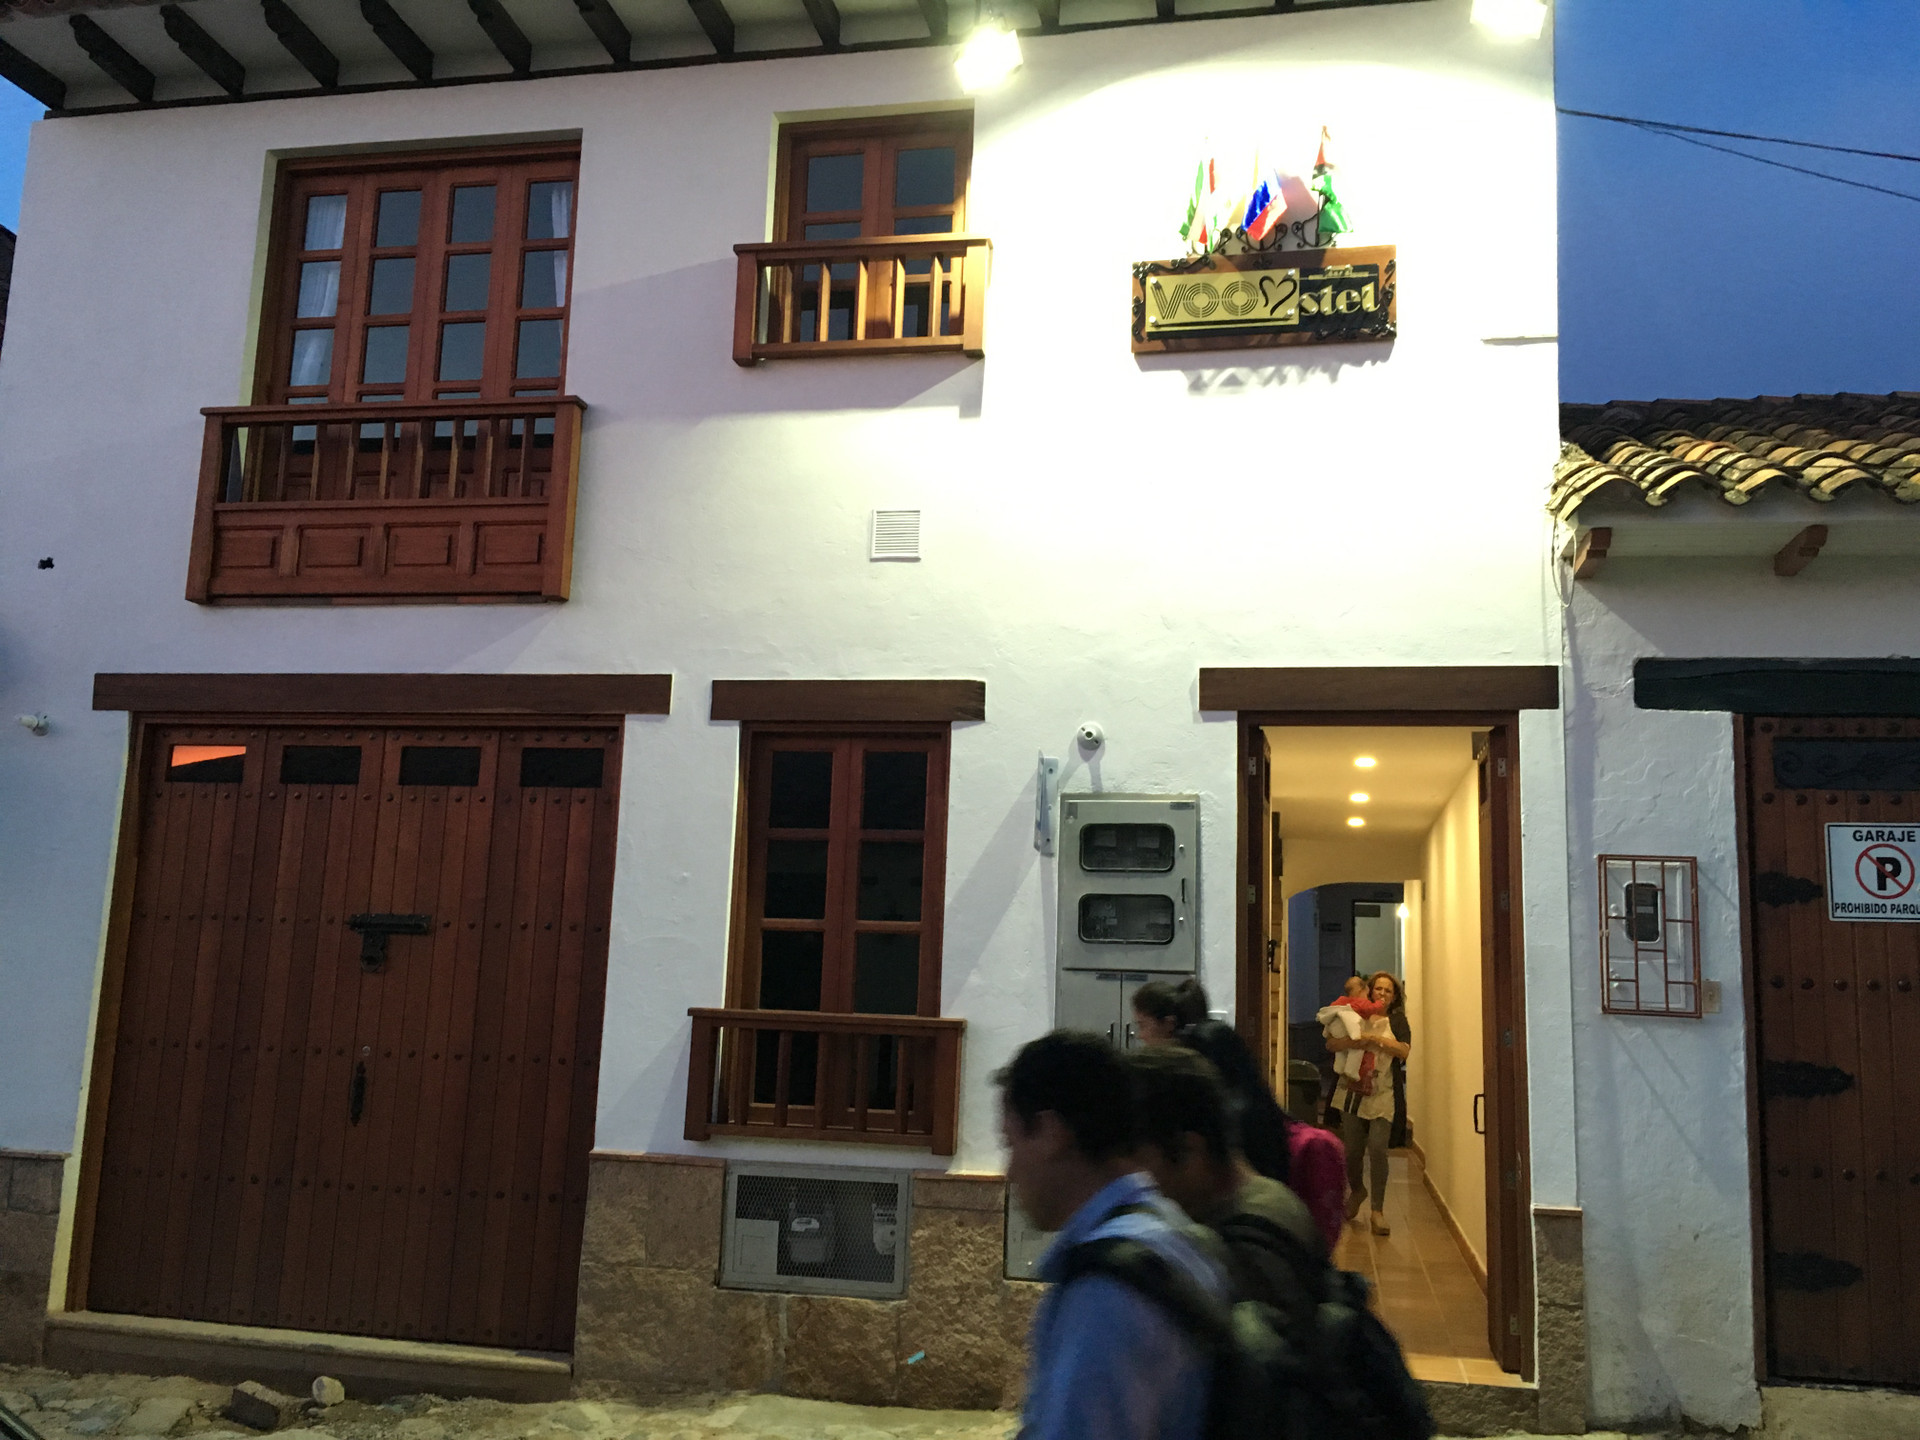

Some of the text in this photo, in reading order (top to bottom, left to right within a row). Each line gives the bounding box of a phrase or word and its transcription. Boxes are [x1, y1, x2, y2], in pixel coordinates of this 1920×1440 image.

[1852, 830, 1916, 842] GARAJE
[1876, 857, 1902, 891] P
[1834, 902, 1888, 914] PROHIBIDO
